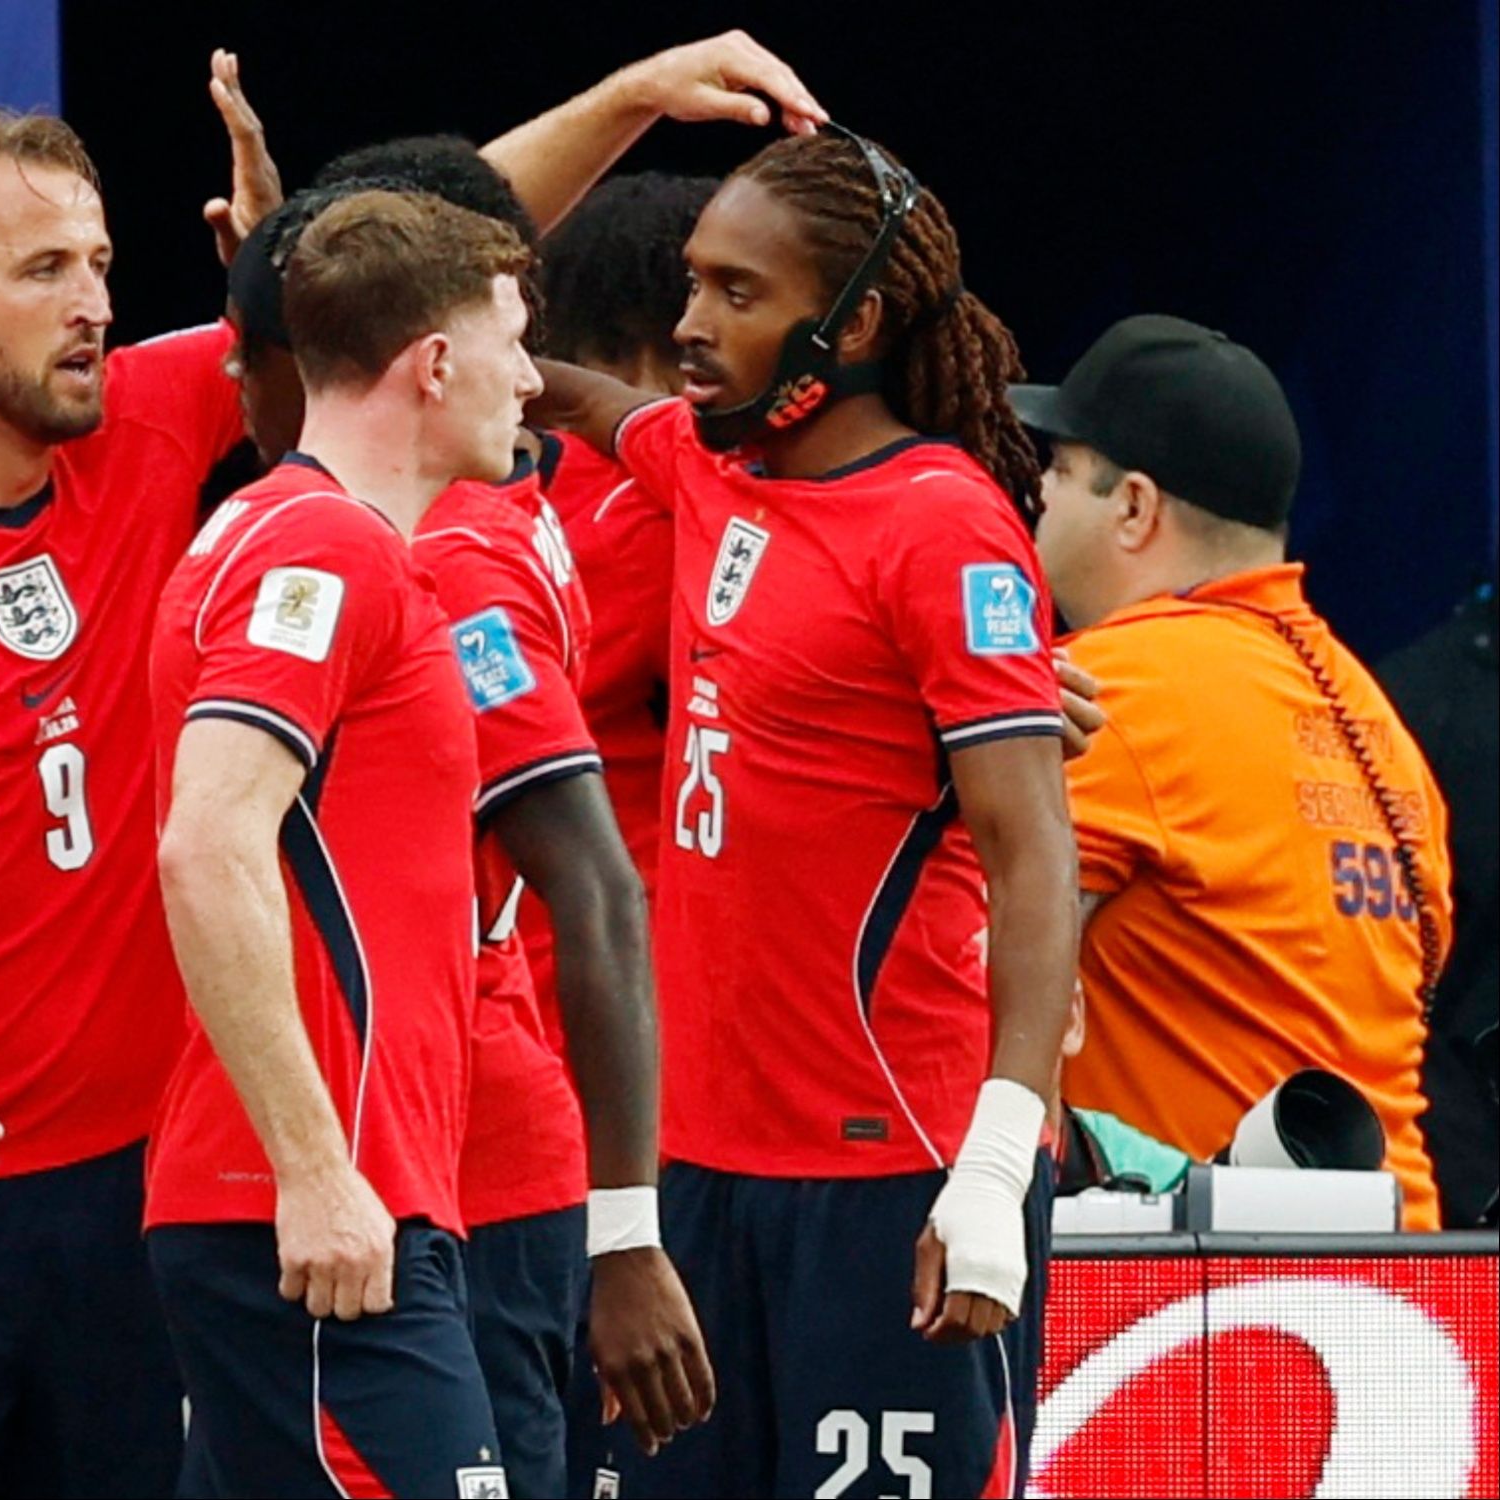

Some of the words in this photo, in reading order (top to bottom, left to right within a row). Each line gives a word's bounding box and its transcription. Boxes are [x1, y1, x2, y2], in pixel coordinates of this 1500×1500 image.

[37, 742, 94, 871] 9
[675, 722, 730, 860] 25
[814, 1409, 935, 1499] 25
